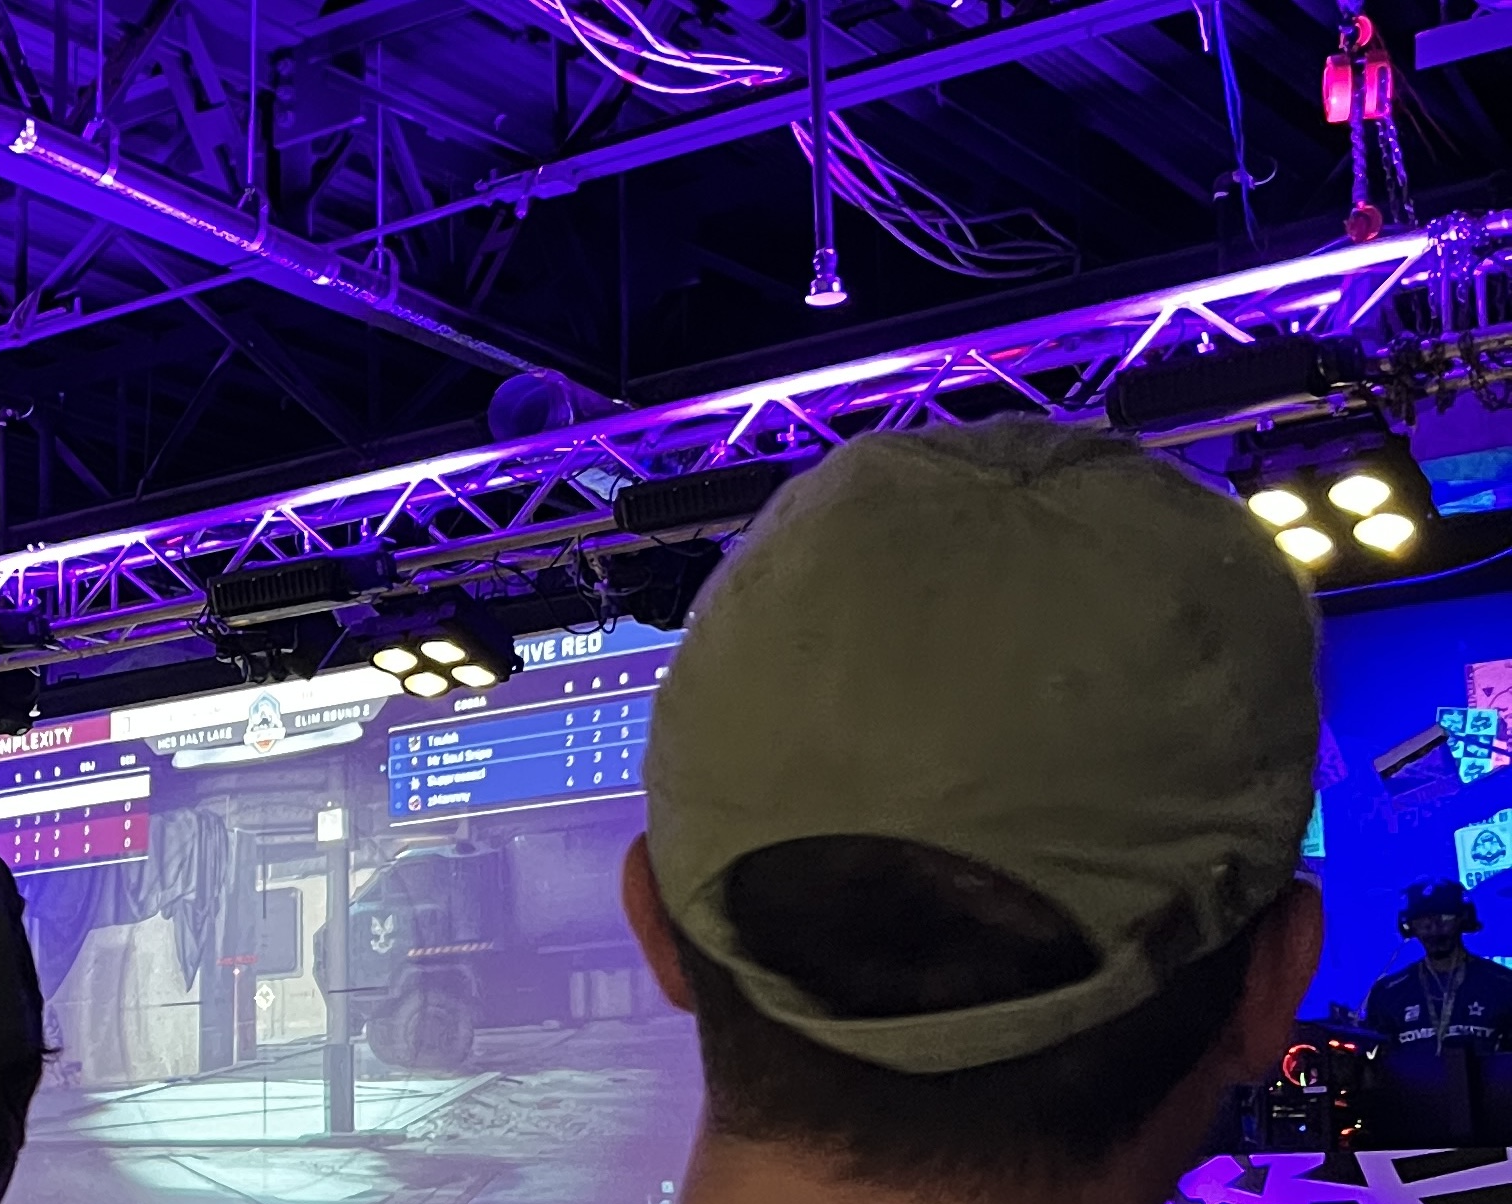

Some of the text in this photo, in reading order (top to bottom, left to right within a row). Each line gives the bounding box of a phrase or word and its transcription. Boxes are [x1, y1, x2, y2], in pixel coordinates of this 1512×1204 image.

[514, 629, 602, 664] TIVE RED
[294, 711, 321, 728] ELIM
[322, 705, 360, 723] ROUND
[180, 731, 205, 747] SALT
[207, 727, 233, 742] LAKE
